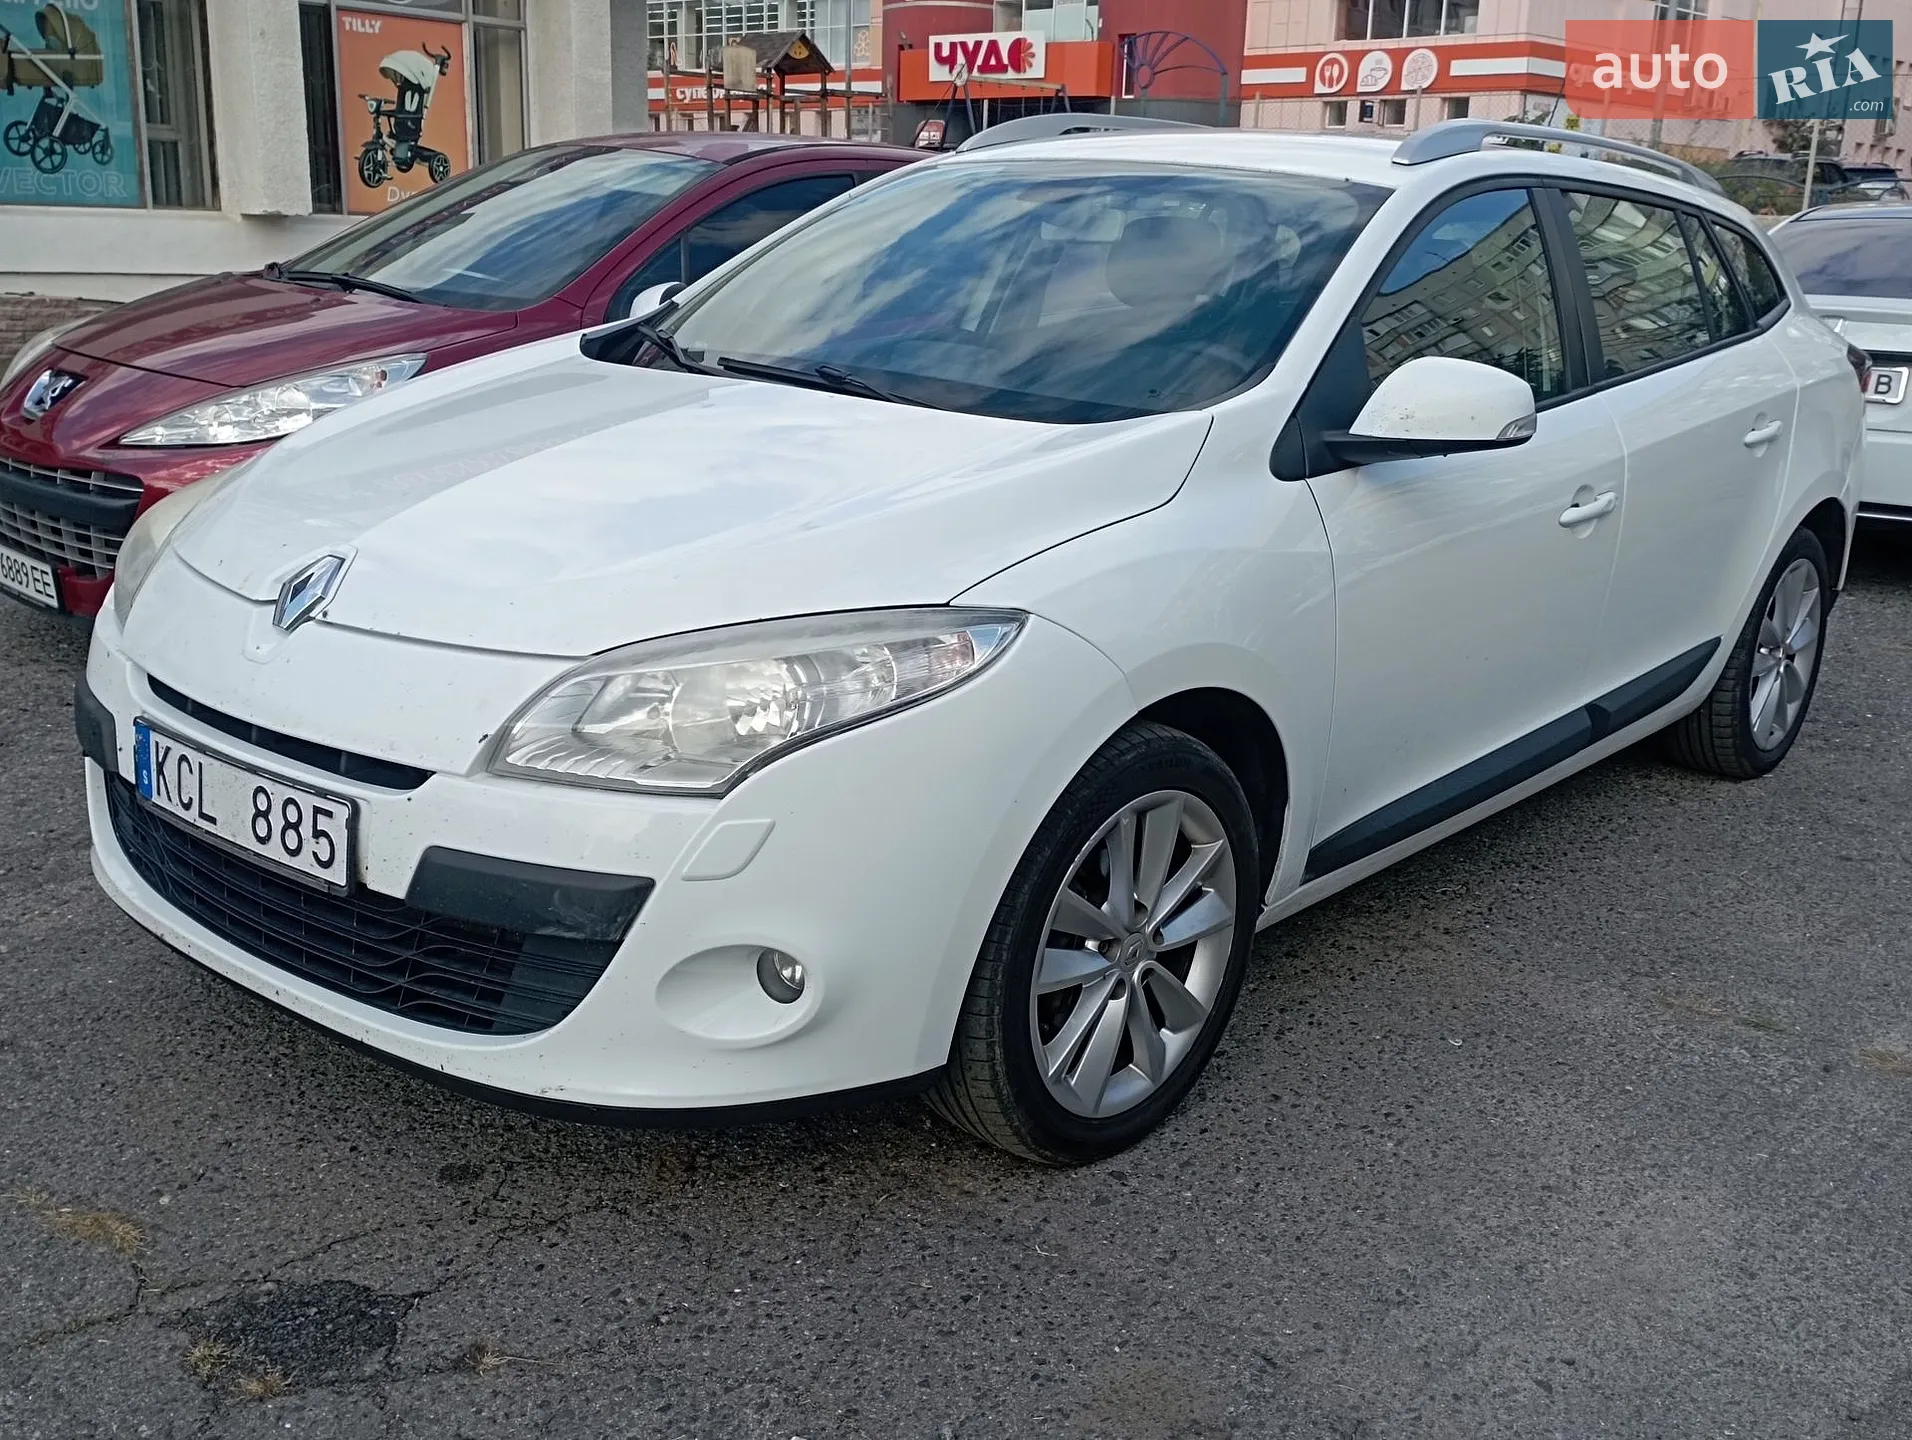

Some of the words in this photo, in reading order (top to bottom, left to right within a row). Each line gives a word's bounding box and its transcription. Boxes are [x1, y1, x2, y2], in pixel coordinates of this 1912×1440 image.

[342, 16, 382, 34] TILLY
[934, 37, 1036, 75] ЧУДО
[1874, 374, 1892, 395] B
[0, 552, 29, 589] 6889
[30, 565, 55, 600] EE
[142, 769, 149, 785] S
[155, 740, 217, 826] KCL
[251, 785, 335, 870] 885
